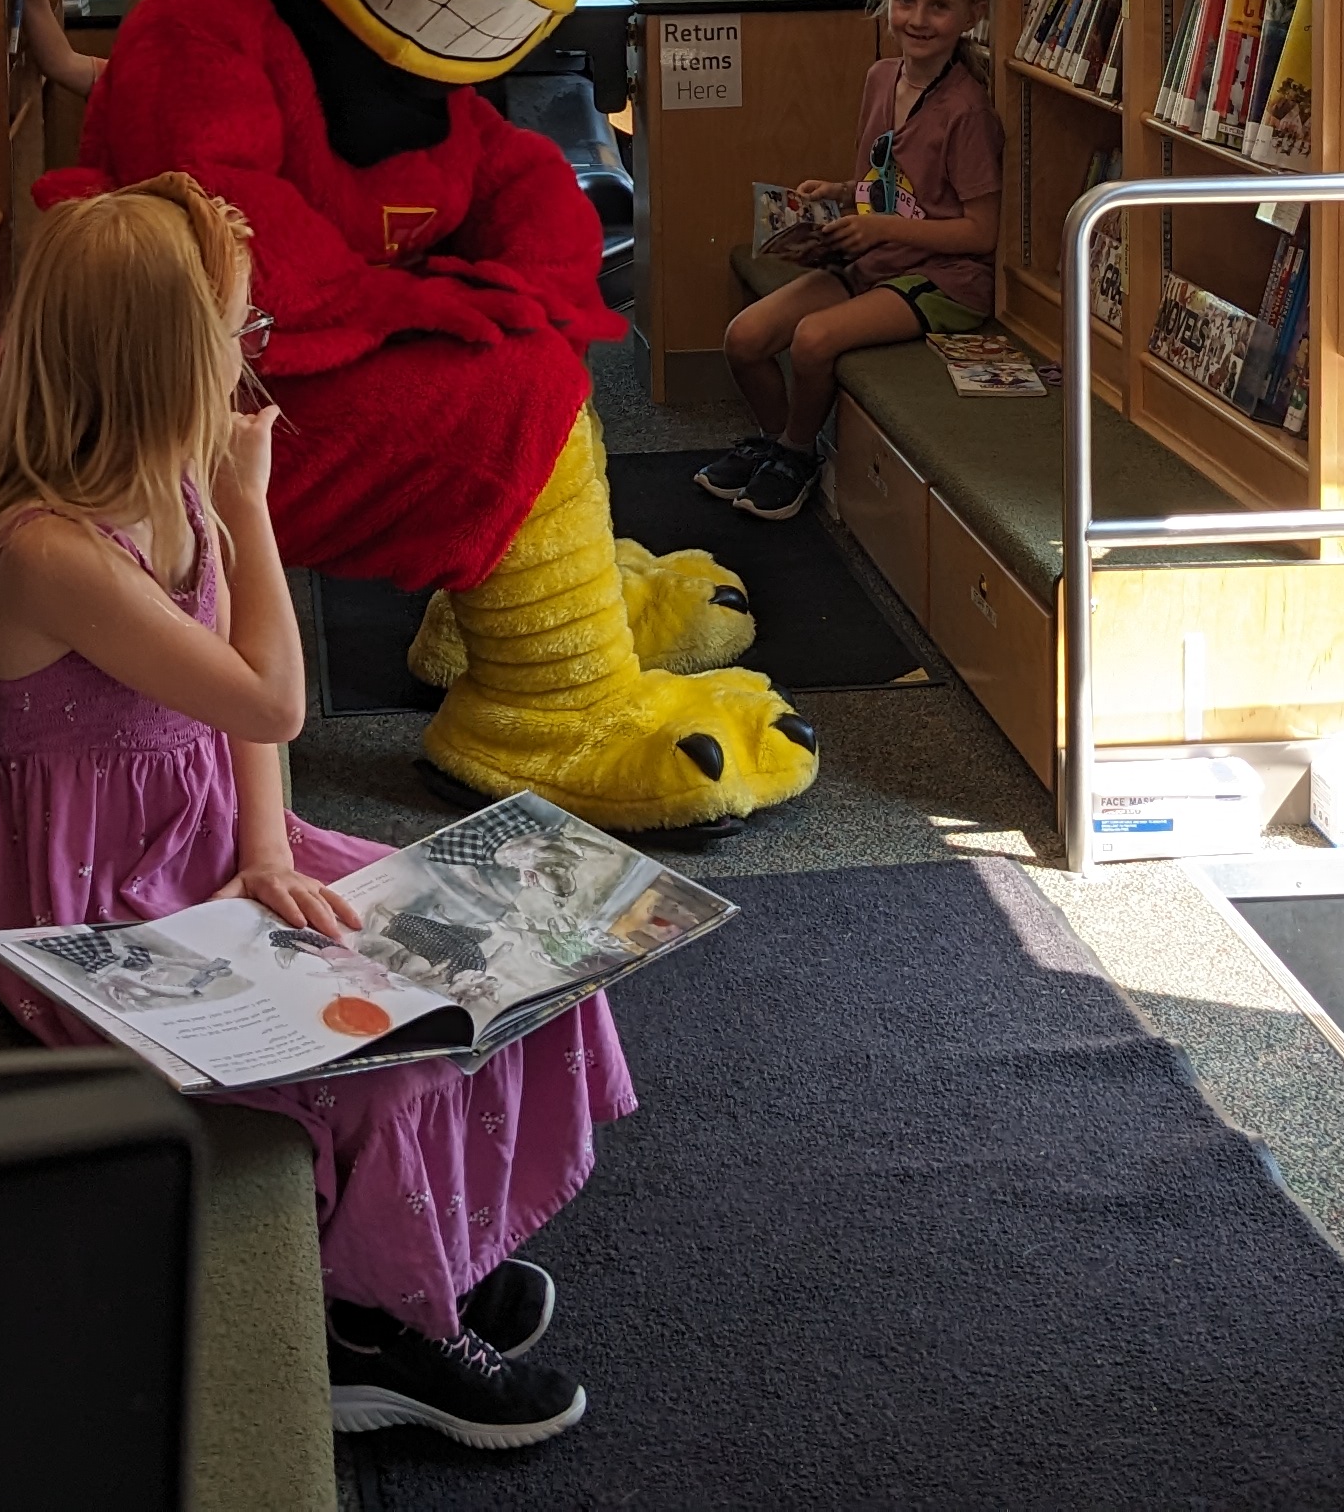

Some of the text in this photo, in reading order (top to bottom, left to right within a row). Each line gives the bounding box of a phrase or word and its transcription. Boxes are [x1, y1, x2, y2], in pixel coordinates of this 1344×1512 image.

[664, 23, 738, 43] Return
[671, 53, 732, 72] Items
[676, 81, 728, 100] Here
[1160, 297, 1210, 355] NOVELS
[1101, 797, 1125, 807] FACE
